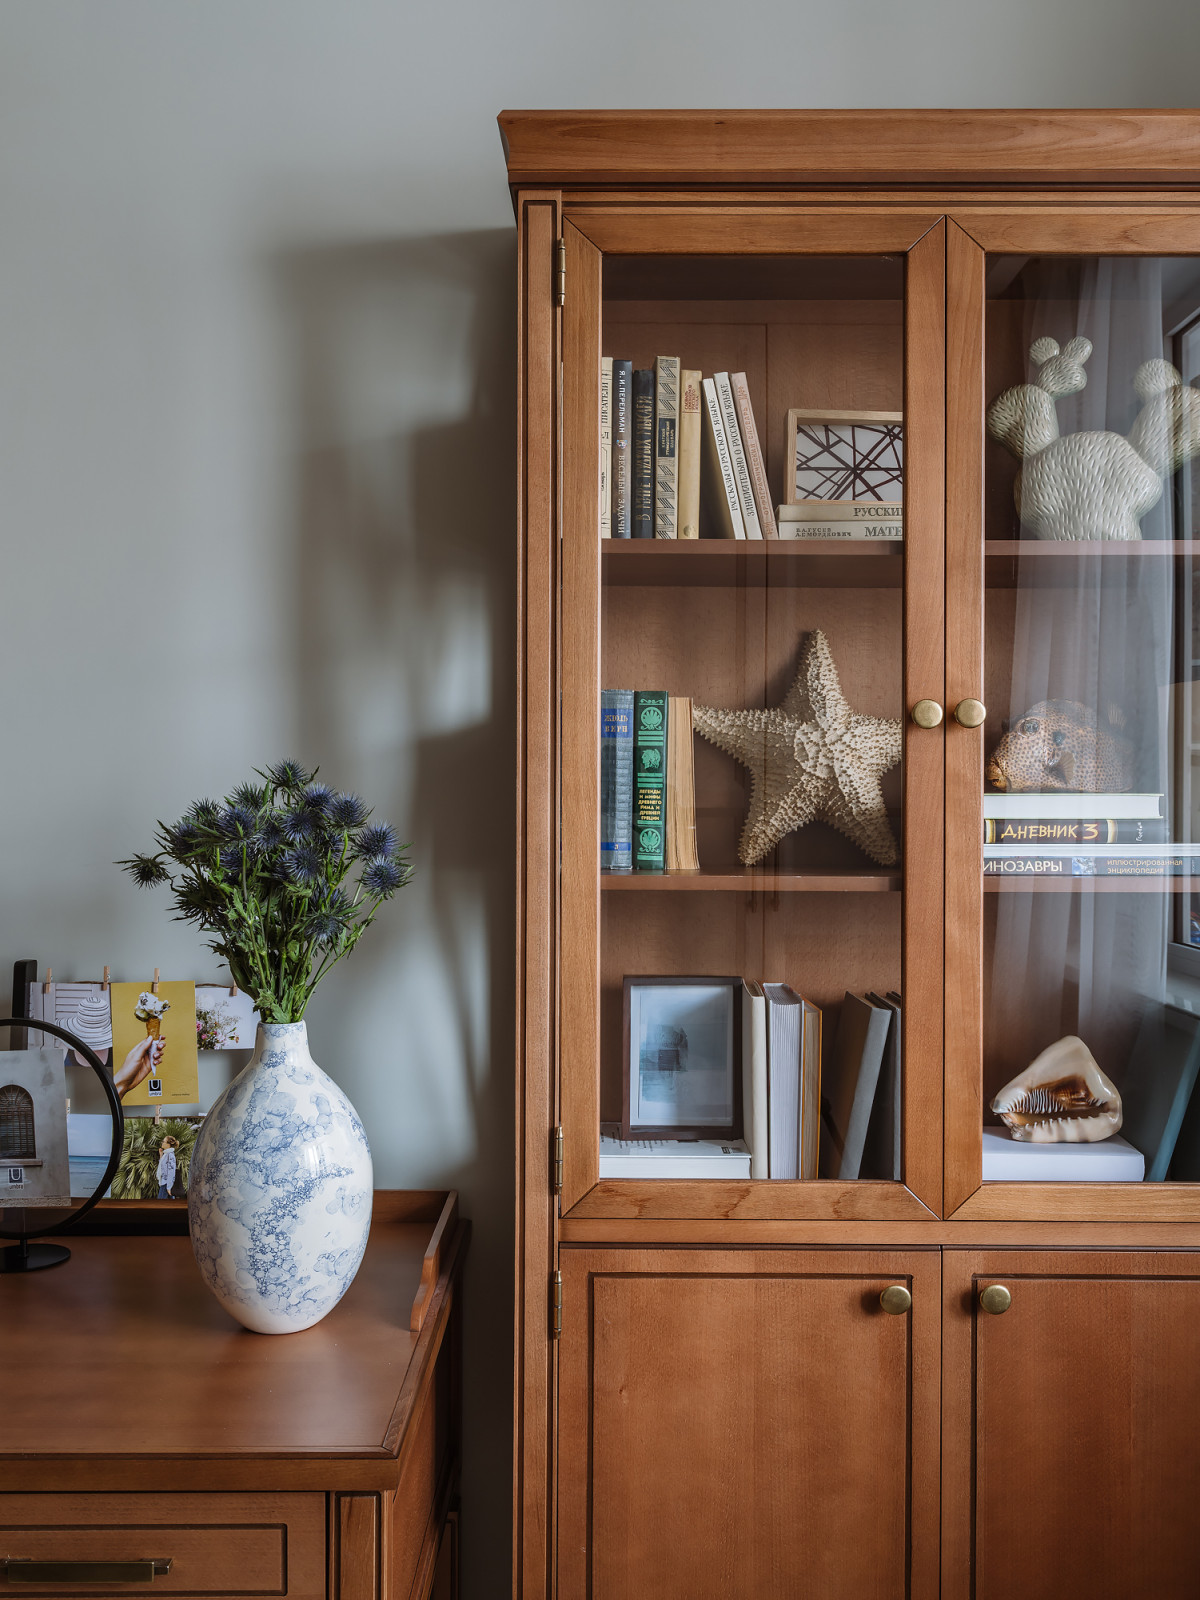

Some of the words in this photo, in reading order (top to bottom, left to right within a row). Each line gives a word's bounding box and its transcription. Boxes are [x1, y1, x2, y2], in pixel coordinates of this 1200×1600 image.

[601, 382, 609, 424] ПИСАТЕЛИ
[708, 397, 720, 426] ЯЗЫКЕ
[720, 383, 733, 410] ЯЗЫКЕ
[636, 395, 652, 435] МЫСЛЕЙ
[726, 412, 741, 447] РУССКОМ
[743, 407, 754, 440] СЛОВАРЬ
[636, 439, 651, 478] МУДРЫХ
[715, 429, 729, 464] РУССКОМ
[618, 455, 626, 495] ВЕСЕЛЫЕ
[735, 457, 755, 517] ЗАНИМАТЕЛЬНО
[750, 443, 769, 516] ОРФОГРАФИЧЕСКИЙ
[636, 482, 651, 509] МИРЕ
[724, 473, 738, 511] РАССКАЗЫ
[616, 499, 625, 533] ЗАДАЧИ
[636, 513, 651, 521] В
[853, 506, 903, 517] РУССКИ
[604, 714, 629, 722] ЖЮЛЬ
[605, 725, 628, 733] ВЕРН
[1001, 824, 1079, 840] ДНЕВНИК
[1083, 823, 1099, 840] 3
[1107, 859, 1183, 868] иллюстрированная
[1107, 867, 1164, 875] энциклопедия
